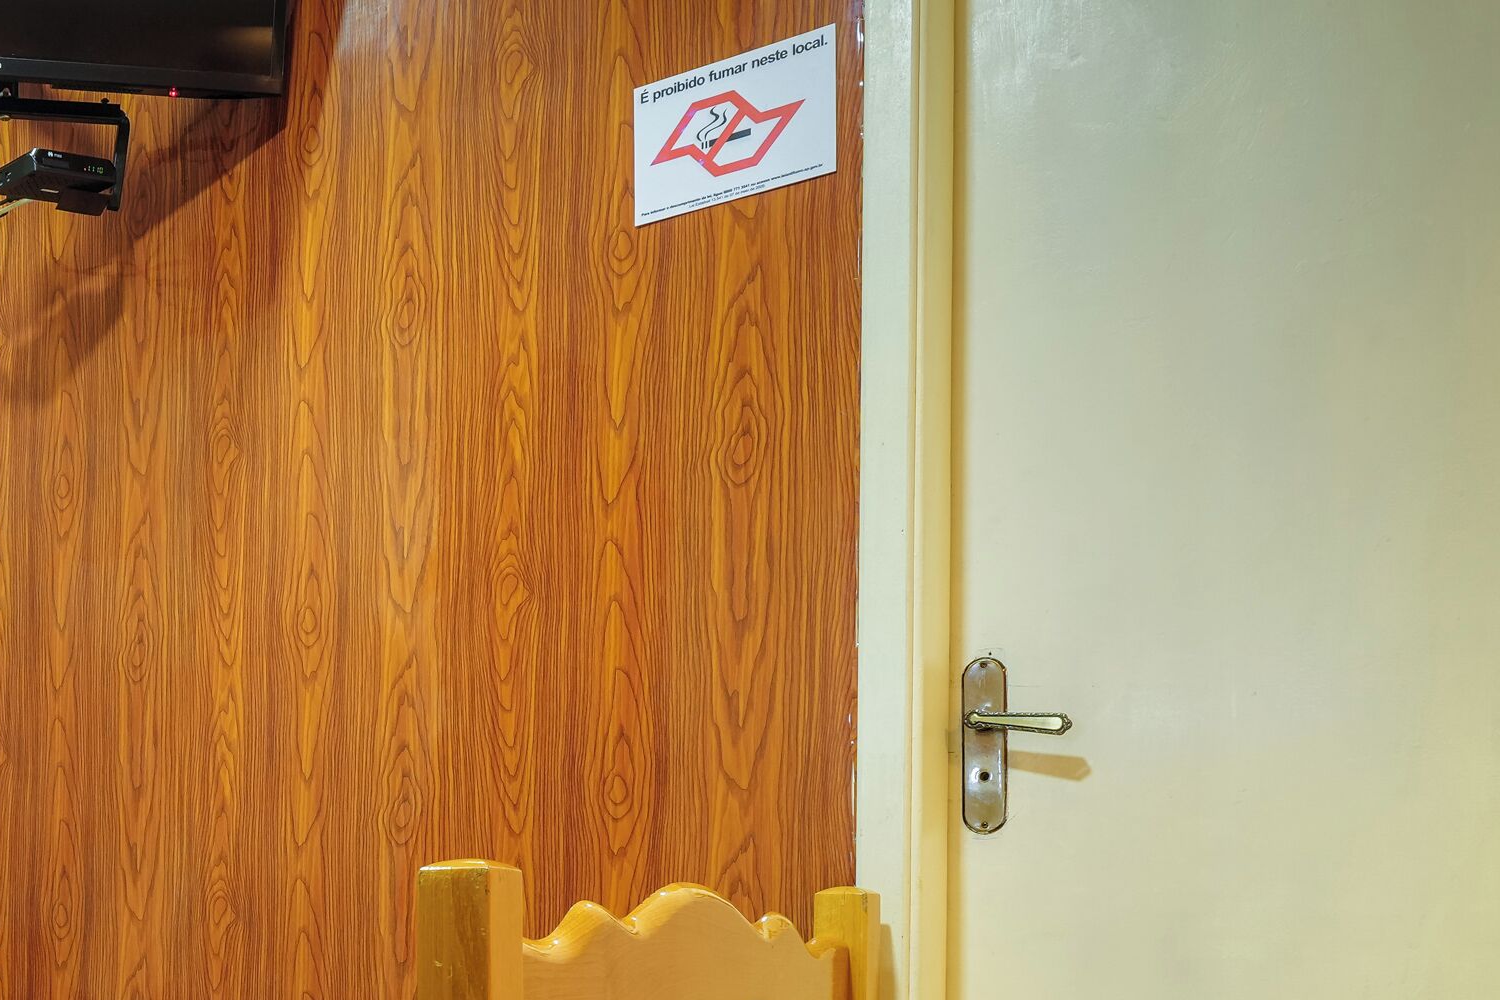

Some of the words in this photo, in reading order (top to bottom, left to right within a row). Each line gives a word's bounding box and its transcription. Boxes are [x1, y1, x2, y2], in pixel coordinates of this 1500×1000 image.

[640, 89, 650, 104] É
[653, 76, 705, 103] proibido
[708, 62, 748, 82] fumar
[751, 49, 788, 69] neste
[792, 34, 828, 55] local.
